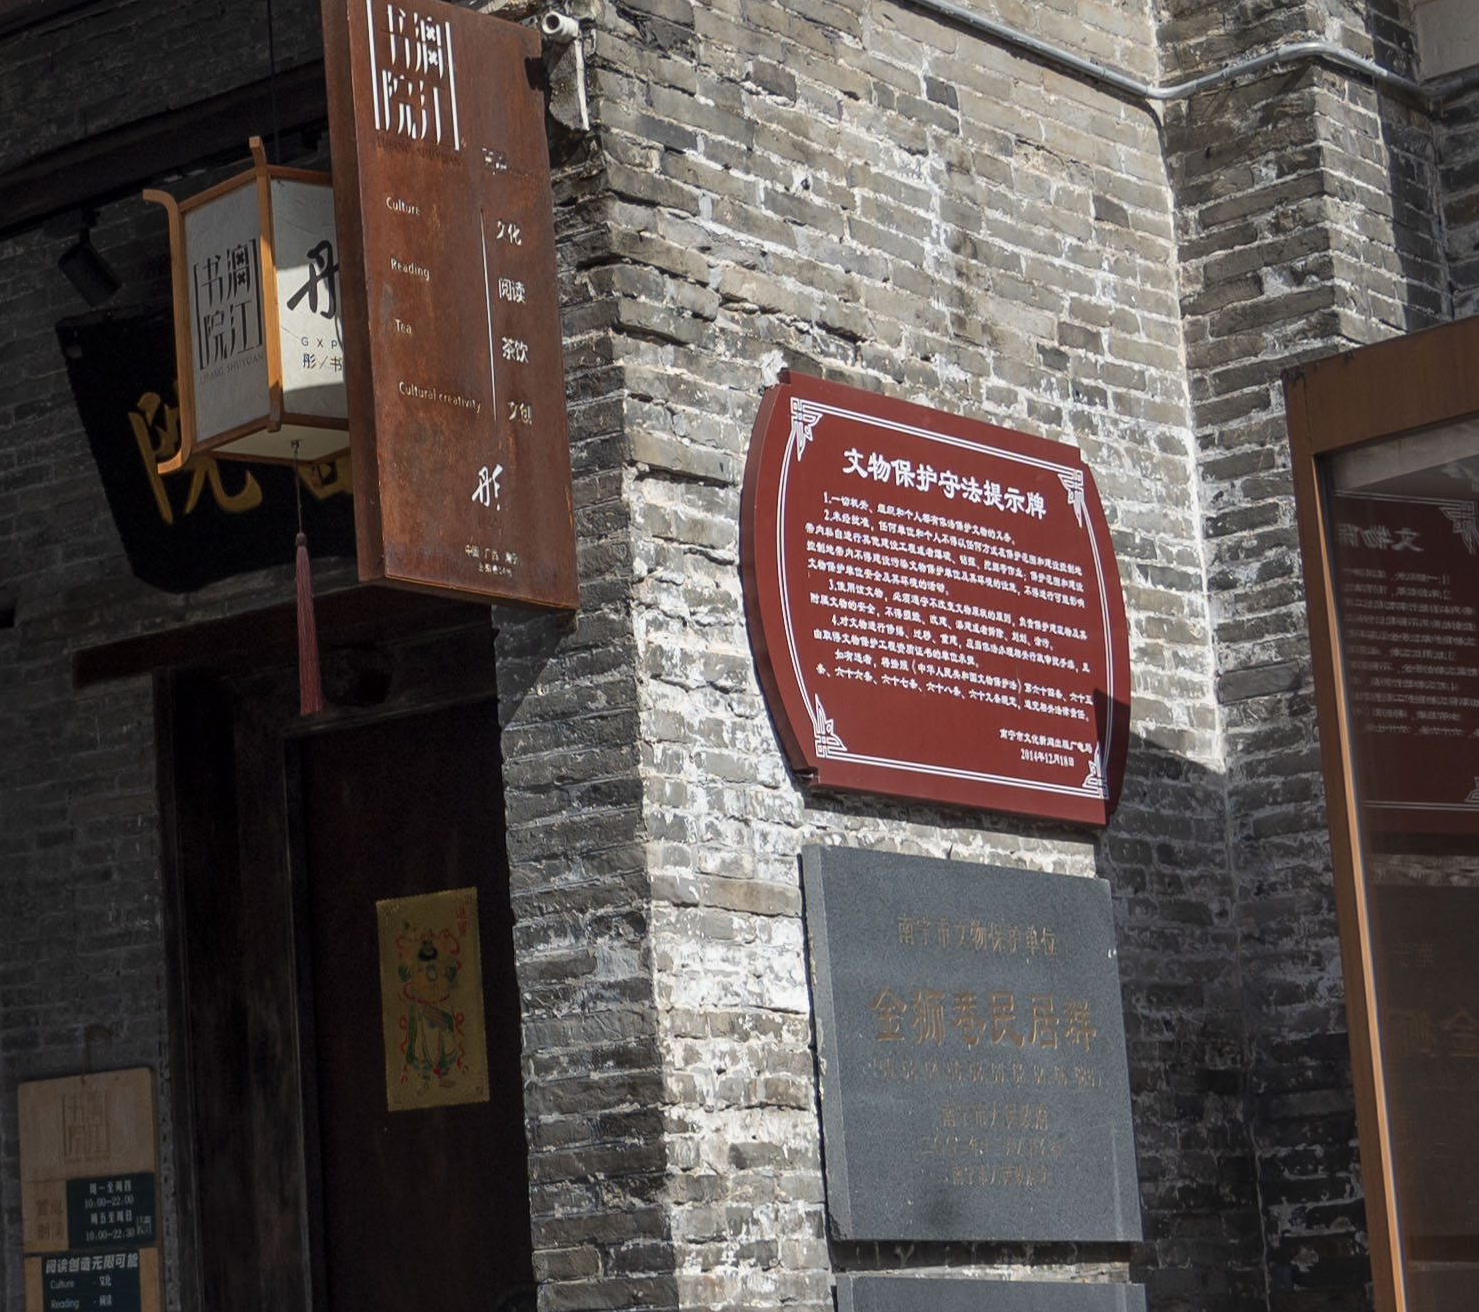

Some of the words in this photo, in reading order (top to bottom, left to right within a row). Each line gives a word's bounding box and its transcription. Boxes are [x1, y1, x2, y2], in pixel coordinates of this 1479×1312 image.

[386, 197, 420, 216] Culture
[496, 220, 522, 245] 文化
[391, 257, 430, 282] Reading
[498, 277, 526, 304] 阅读
[395, 319, 412, 335] Tea
[501, 337, 529, 363] 茶饮
[399, 381, 436, 401] Cultural
[439, 393, 481, 414] creativity
[842, 448, 1047, 520] 文物保护守法提示牌
[898, 913, 1057, 956] 南宁市文物保护单位
[869, 983, 1097, 1053] 金狮巷民居群
[45, 1253, 138, 1274] 阅读创造无限可能
[50, 1279, 75, 1289] Culture
[51, 1298, 80, 1310] Reading
